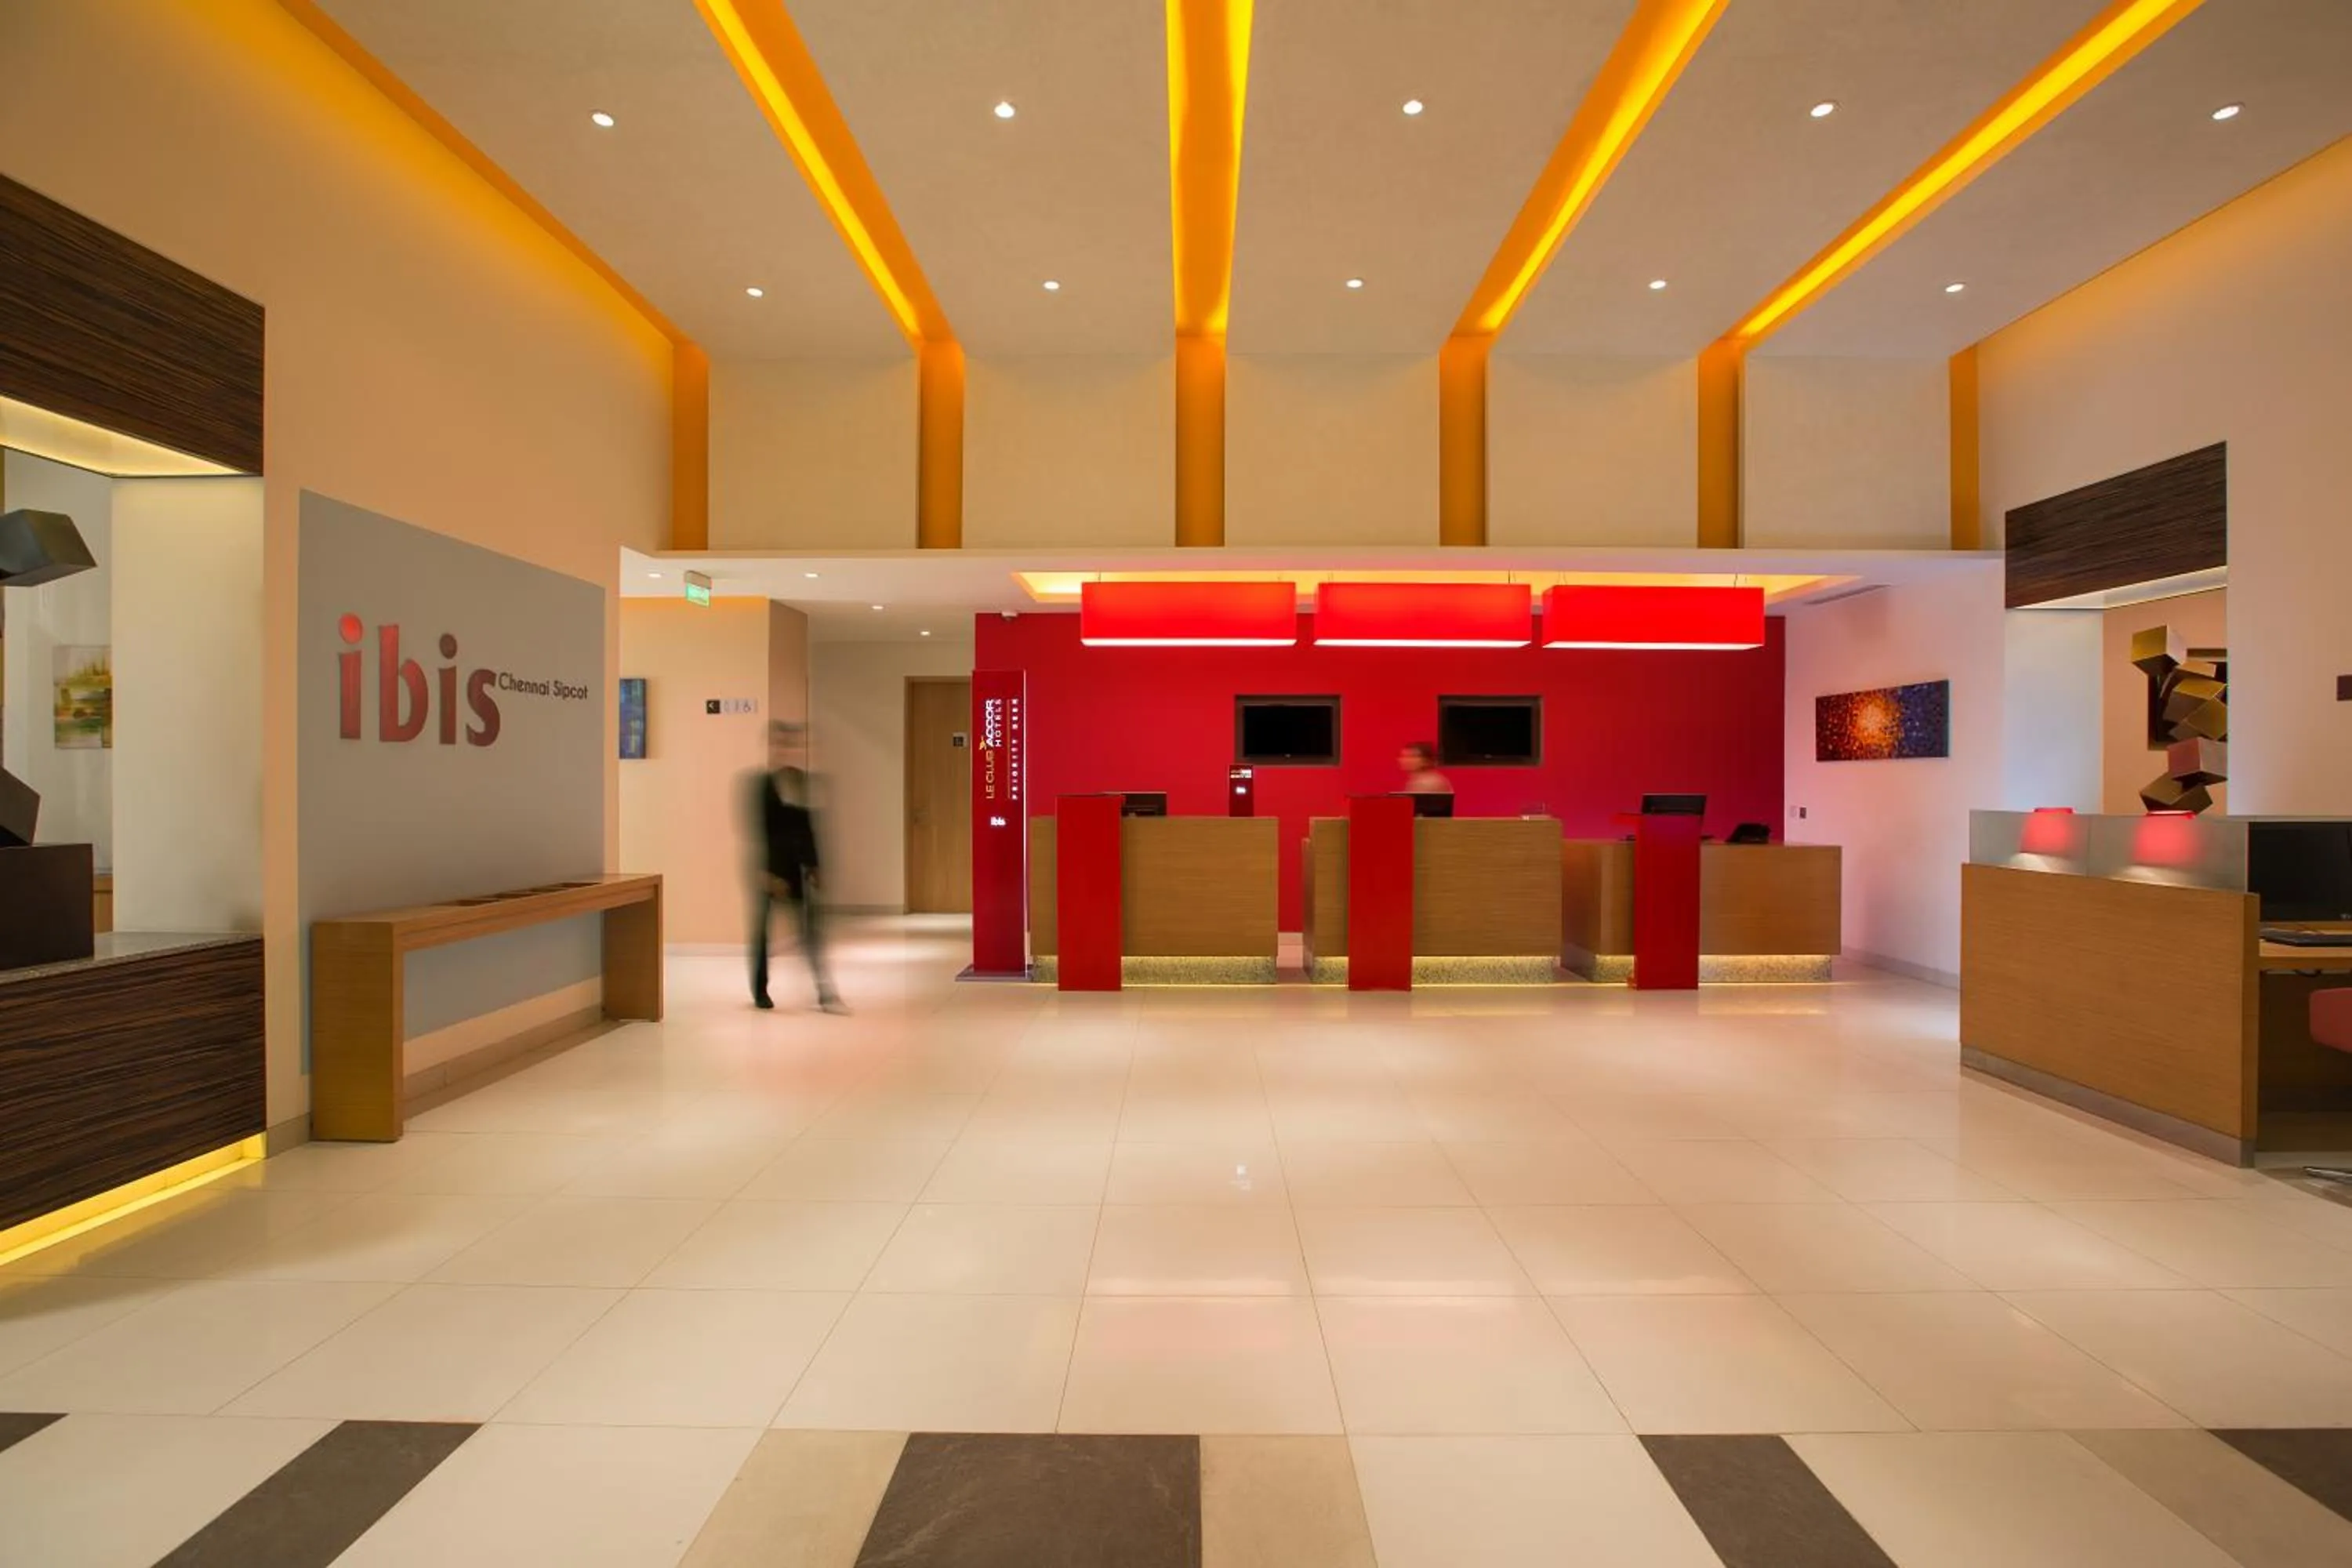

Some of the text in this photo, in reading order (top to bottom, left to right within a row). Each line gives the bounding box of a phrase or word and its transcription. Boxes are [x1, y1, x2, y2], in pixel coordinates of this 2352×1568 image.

[338, 612, 501, 747] ibis
[499, 672, 589, 700] Chennai Sipcot
[985, 699, 995, 799] LE CLUB ACCOR
